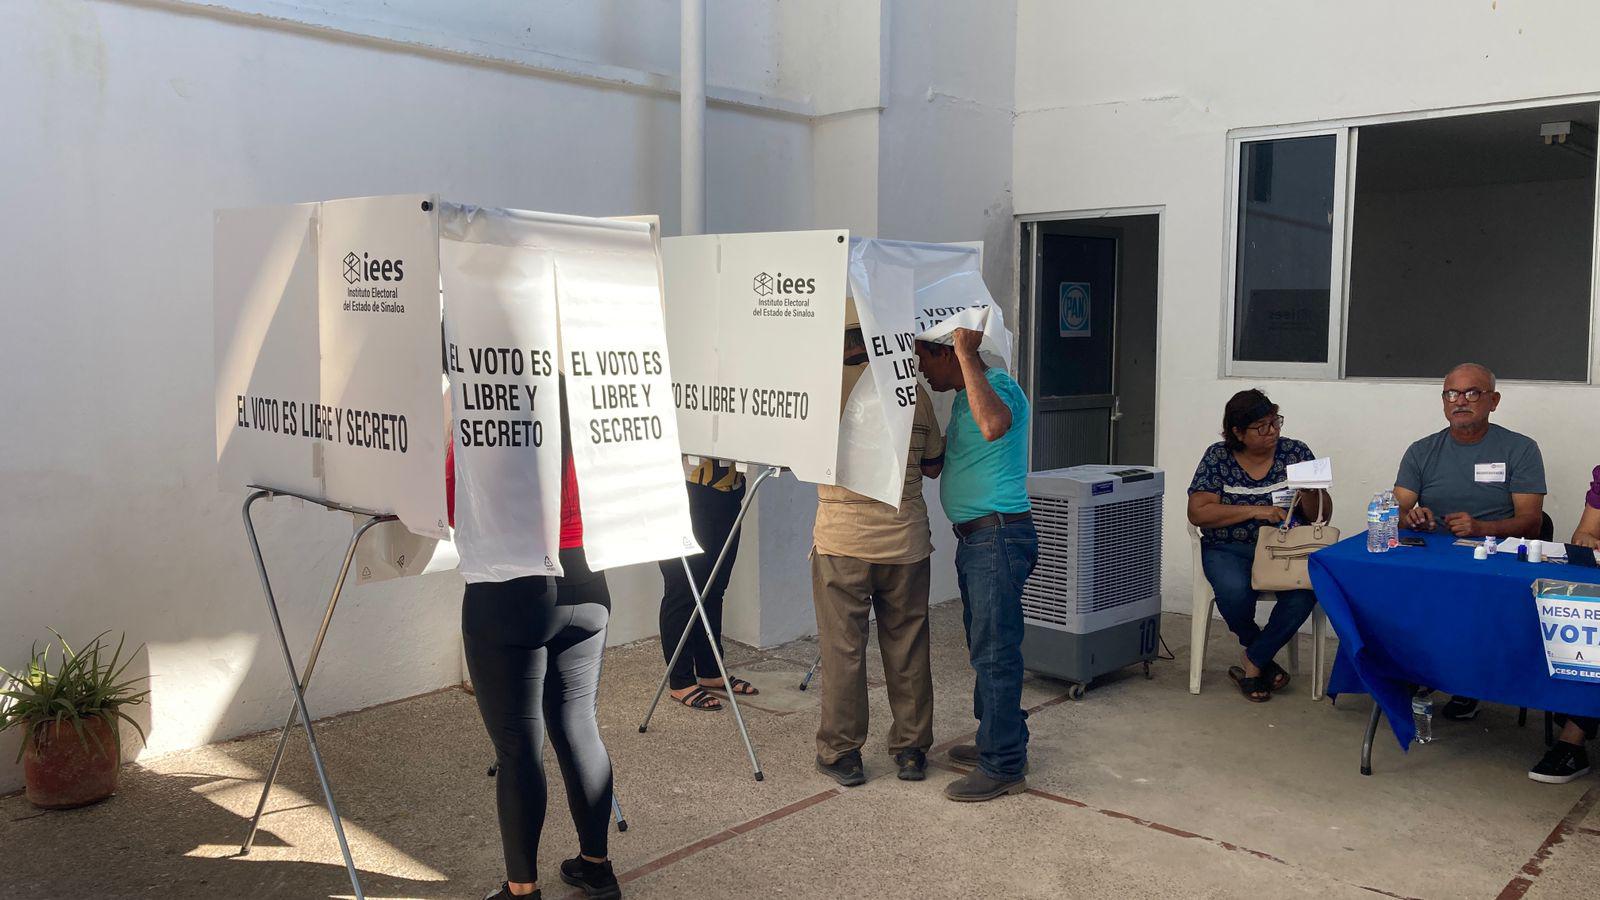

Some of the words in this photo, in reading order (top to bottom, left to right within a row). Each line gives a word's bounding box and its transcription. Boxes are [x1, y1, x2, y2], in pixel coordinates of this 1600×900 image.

[364, 252, 404, 281] iees
[347, 287, 370, 297] Instituto
[371, 287, 398, 298] Electoral
[777, 272, 816, 294] iees
[343, 300, 351, 311] del
[352, 301, 371, 311] Estado
[372, 301, 380, 312] de
[380, 302, 405, 313] Sinaloa
[752, 307, 762, 316] del
[763, 308, 783, 317] Estado
[784, 308, 792, 316] de
[792, 308, 815, 317] Sinaloa
[758, 298, 783, 306] Instituto
[784, 298, 809, 306] Electoral
[1066, 297, 1086, 318] PAN
[872, 335, 893, 357] EL
[449, 343, 465, 373] EL
[469, 347, 524, 376] VOTO
[531, 350, 552, 376] ES
[571, 351, 592, 376] EL
[596, 351, 639, 376] VOTO
[643, 351, 662, 375] ES
[463, 383, 520, 411] LIBRE
[525, 385, 537, 411] Y
[591, 384, 638, 409] LIBRE
[642, 384, 651, 407] Y
[685, 384, 698, 410] ES
[702, 385, 735, 413] LIBRE
[740, 388, 748, 414] Y
[752, 388, 809, 420] SECRETO
[237, 395, 250, 428] EL
[251, 396, 279, 433] VOTO
[282, 400, 297, 436] ES
[301, 403, 333, 441] LIBRE
[335, 408, 343, 443] Y
[346, 408, 408, 454] SECRETO
[460, 419, 543, 447] SECRETO
[590, 415, 662, 444] SECRETO
[1542, 605, 1580, 619] MESA
[1541, 622, 1600, 645] VOT
